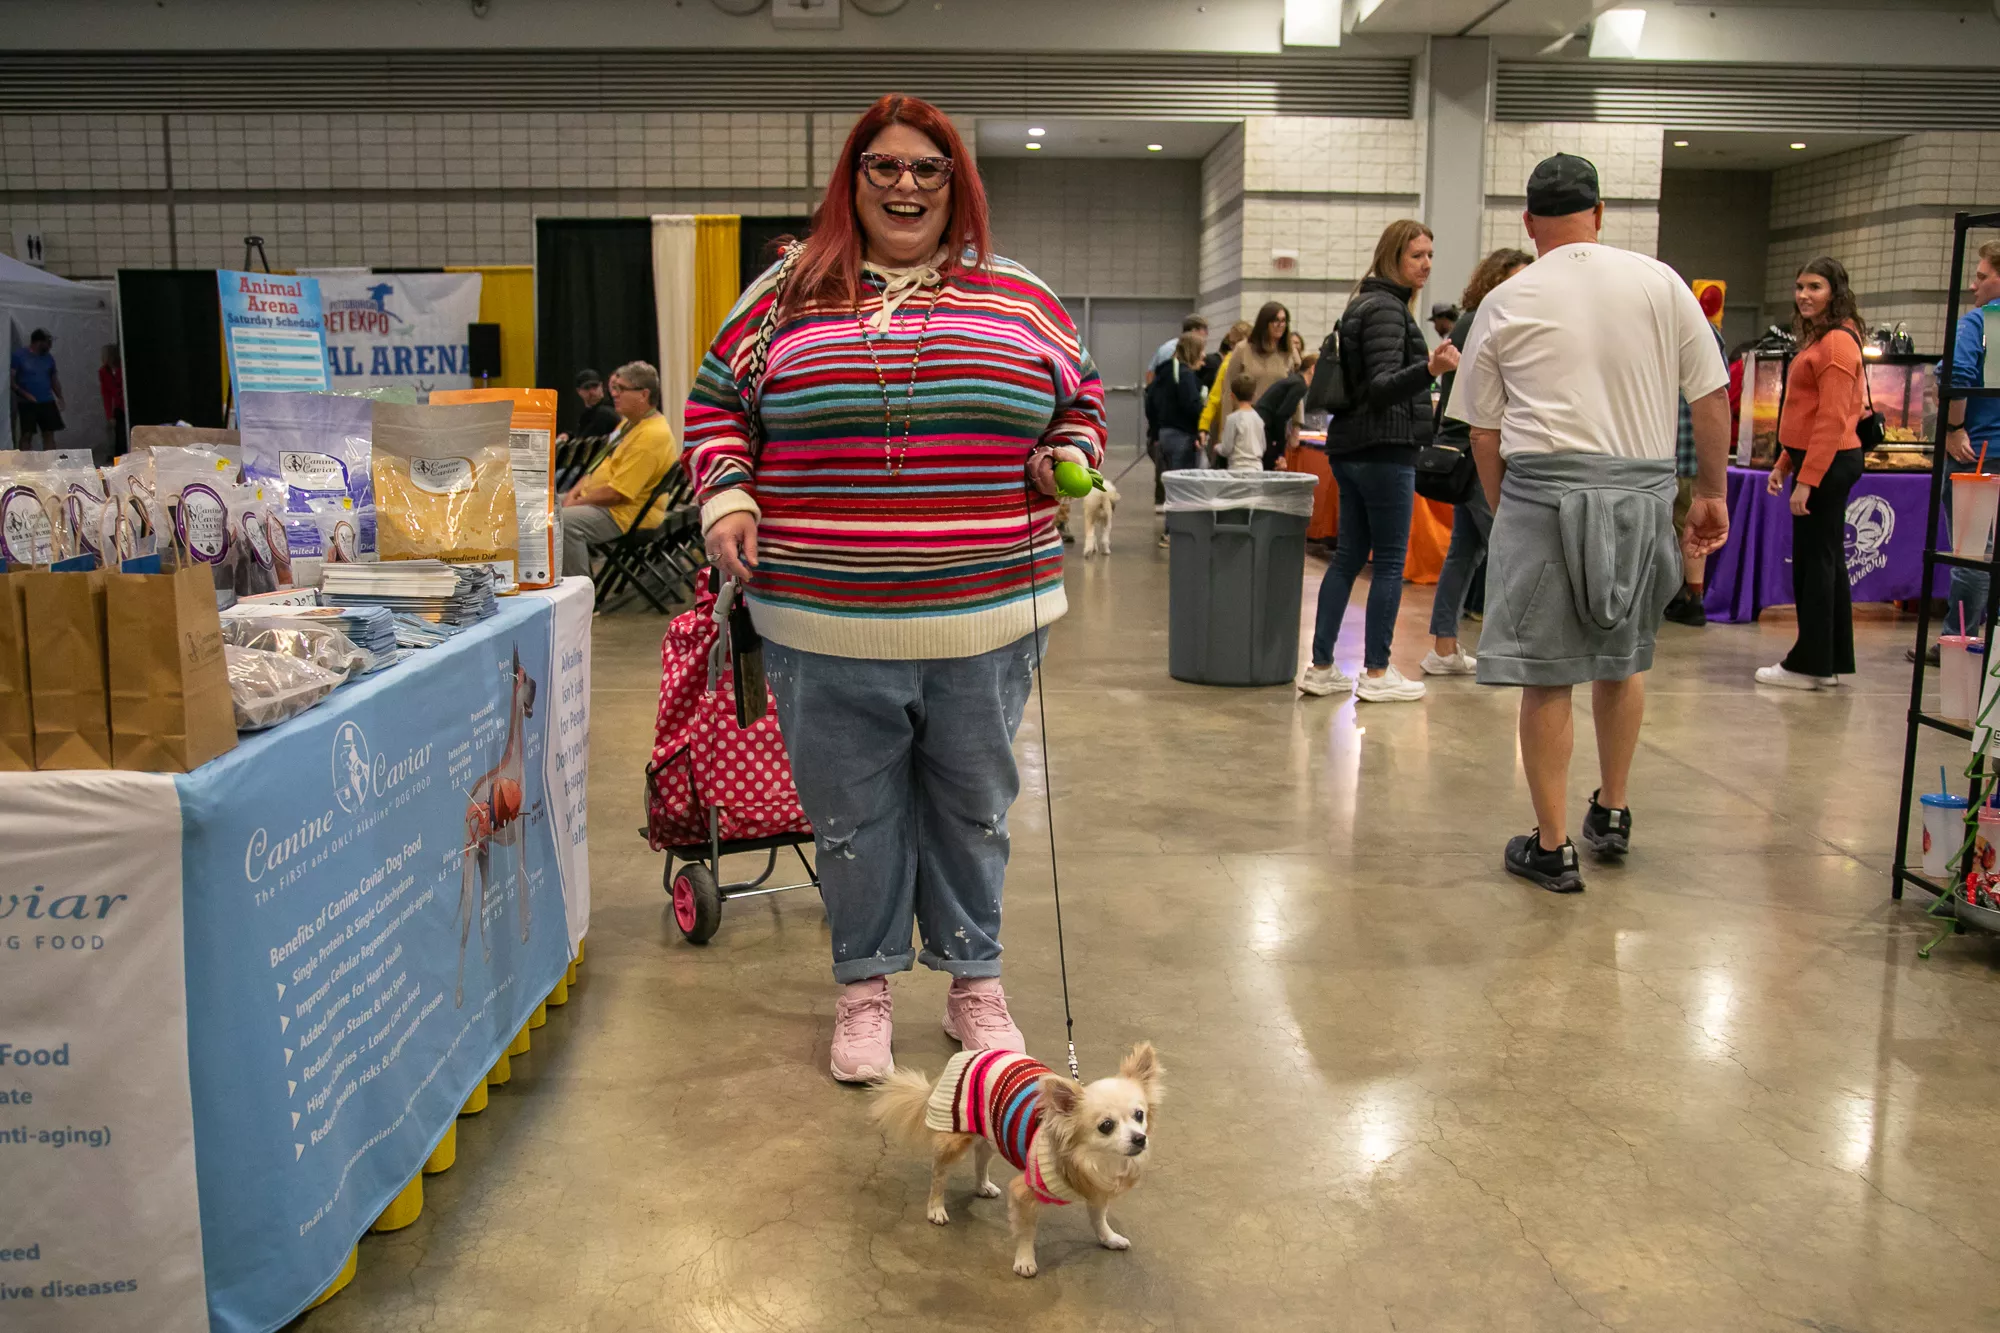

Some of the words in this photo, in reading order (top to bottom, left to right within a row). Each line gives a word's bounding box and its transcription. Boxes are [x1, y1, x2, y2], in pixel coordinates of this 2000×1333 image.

[239, 276, 303, 298] Animal
[248, 296, 299, 314] Arena
[227, 312, 273, 328] Saturday
[276, 316, 320, 328] Schedule
[348, 311, 389, 335] EXPO
[303, 455, 336, 465] Canine
[303, 463, 337, 474] Caviar
[430, 459, 461, 470] Canine
[430, 467, 461, 477] Caviar
[290, 546, 316, 556] mited
[360, 543, 375, 551] Diet
[440, 554, 479, 563] Ingredient
[1848, 553, 1888, 586] ursery
[561, 648, 583, 675] Alkaline
[562, 682, 573, 705] isn't
[573, 676, 584, 699] just
[559, 716, 569, 738] for
[569, 706, 586, 733] People
[448, 756, 473, 777] Secretion
[245, 810, 333, 882] Canine
[373, 743, 433, 797] Caviar
[255, 887, 275, 906] The
[279, 862, 307, 890] FIRST
[311, 847, 328, 868] and
[331, 829, 354, 853] ONLY
[395, 790, 410, 808] DOG
[412, 775, 431, 796] FOOD
[0, 885, 128, 920] viar
[270, 923, 314, 968] Benefits
[316, 907, 326, 931] of
[328, 890, 359, 921] Canine
[360, 866, 385, 896] Caviar
[386, 852, 402, 874] Dog
[403, 833, 422, 858] Food
[292, 956, 318, 986] Single
[319, 932, 345, 963] Protein
[346, 925, 354, 939] &
[354, 908, 376, 932] Single
[375, 874, 415, 914] Carbohydrate
[331, 953, 360, 984] Cellular
[361, 914, 400, 960] Regeneration
[400, 885, 434, 925] (anti-aging)
[35, 935, 104, 950] FOOD
[300, 1009, 327, 1051] Added
[352, 982, 365, 998] for
[366, 962, 384, 988] Heart
[385, 942, 403, 969] Health
[347, 1007, 373, 1035] Stains
[374, 999, 381, 1013] &
[381, 986, 393, 1007] Hot
[393, 970, 407, 994] Spots
[368, 1022, 391, 1049] Lower
[390, 1007, 402, 1028] Cost
[402, 1001, 408, 1013] to
[359, 1063, 381, 1086] risks
[382, 1055, 390, 1069] &
[420, 991, 444, 1021] diseases
[0, 1042, 70, 1066] Food
[0, 1125, 111, 1148] nti-aging)
[300, 1206, 323, 1237] Email
[325, 1200, 333, 1213] us
[0, 1243, 40, 1261] eed
[0, 1281, 34, 1299] ive
[41, 1278, 138, 1298] diseases
